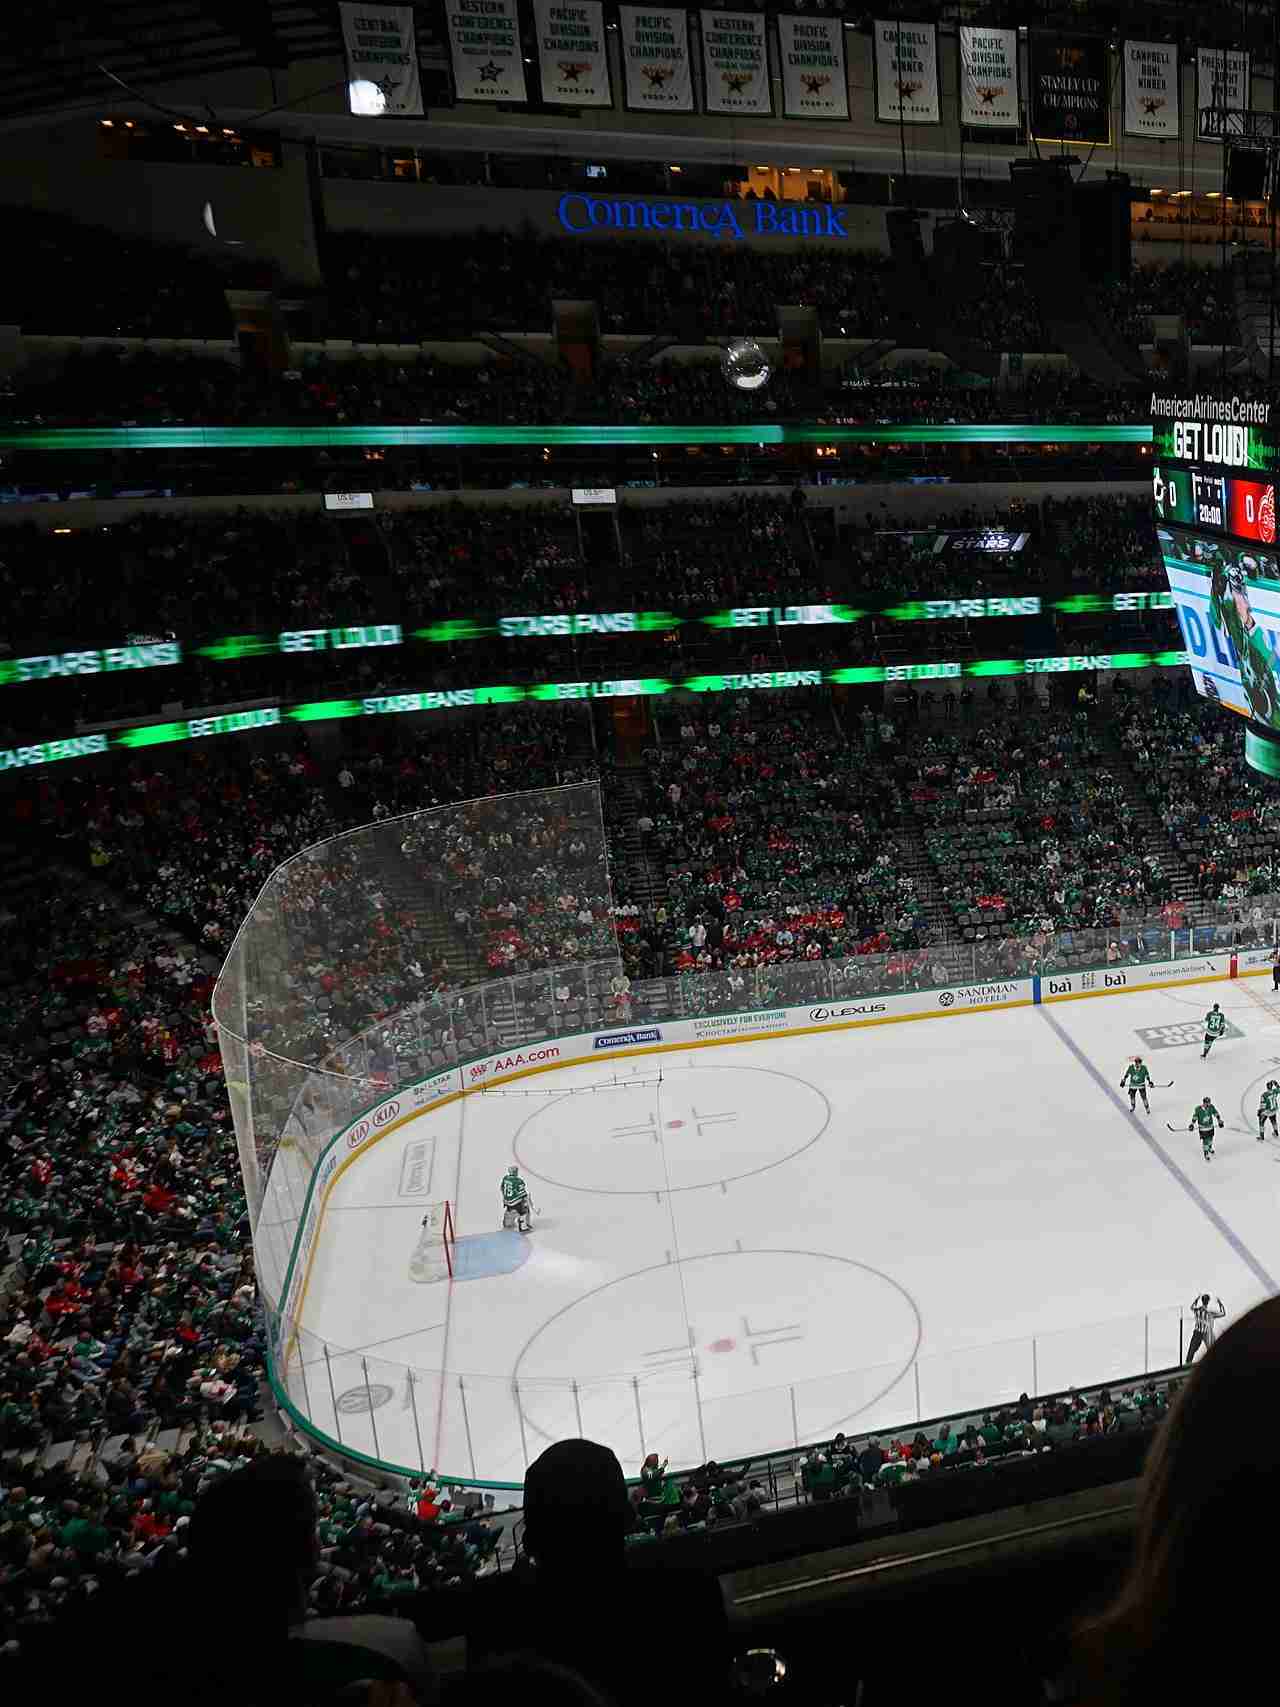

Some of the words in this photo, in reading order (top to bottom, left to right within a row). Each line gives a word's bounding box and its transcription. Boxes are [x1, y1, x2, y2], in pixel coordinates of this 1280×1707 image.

[550, 8, 587, 21] PACIFIC
[635, 16, 672, 29] PACIFIC
[713, 17, 755, 31] WESTERN
[635, 31, 674, 44] DIVISION
[793, 24, 828, 37] PACIFIC
[883, 30, 928, 45] CAMPBELL
[544, 38, 599, 52] CHAMPIONS
[706, 32, 763, 46] CONFERENCE
[793, 40, 832, 52] DIVISION
[972, 37, 1004, 50] PACIFIC
[630, 46, 684, 59] CHAMPIONS
[710, 47, 761, 60] CHAMPIONS
[895, 47, 917, 59] BOWL
[972, 52, 1006, 64] DIVISION
[1131, 49, 1171, 64] CAMPBELL
[788, 53, 839, 67] CHAMPIONS
[891, 61, 924, 73] WINNER
[966, 65, 1013, 78] CHAMPIONS
[1141, 64, 1163, 76] BOWL
[1039, 74, 1078, 91] STANLEY
[1080, 77, 1101, 92] CUP
[1138, 77, 1166, 90] WINNER
[1041, 92, 1101, 110] CHAMPIONS
[755, 202, 848, 238] Bank
[1150, 392, 1270, 424] AmericanAirlinesCenter
[1174, 421, 1201, 461] GET
[1204, 423, 1248, 467] LOUD!
[1169, 481, 1177, 507] 0
[1199, 503, 1221, 525] 20:00
[1246, 495, 1254, 523] 0
[952, 539, 1010, 549] STARS
[925, 598, 986, 618] STARS
[732, 608, 769, 627] GET
[499, 614, 571, 636] STARS
[279, 630, 326, 652] GET
[17, 651, 101, 681] STARS
[104, 643, 182, 671] FANS!
[1025, 657, 1070, 673] STARS
[885, 665, 913, 681] GET
[916, 662, 961, 679] LOUD!
[722, 673, 771, 691] STARS
[556, 682, 589, 699] GET
[362, 694, 418, 714] STARS
[188, 718, 223, 738] GET
[957, 984, 1018, 998] SANDMAN
[969, 994, 1007, 1004] HOTELS
[831, 1004, 886, 1017] LEXUS
[1210, 1016, 1221, 1029] 34
[637, 1030, 657, 1041] Bank
[494, 1045, 560, 1073] AAA.com
[376, 1105, 396, 1124] KIA
[350, 1123, 368, 1145] KIA
